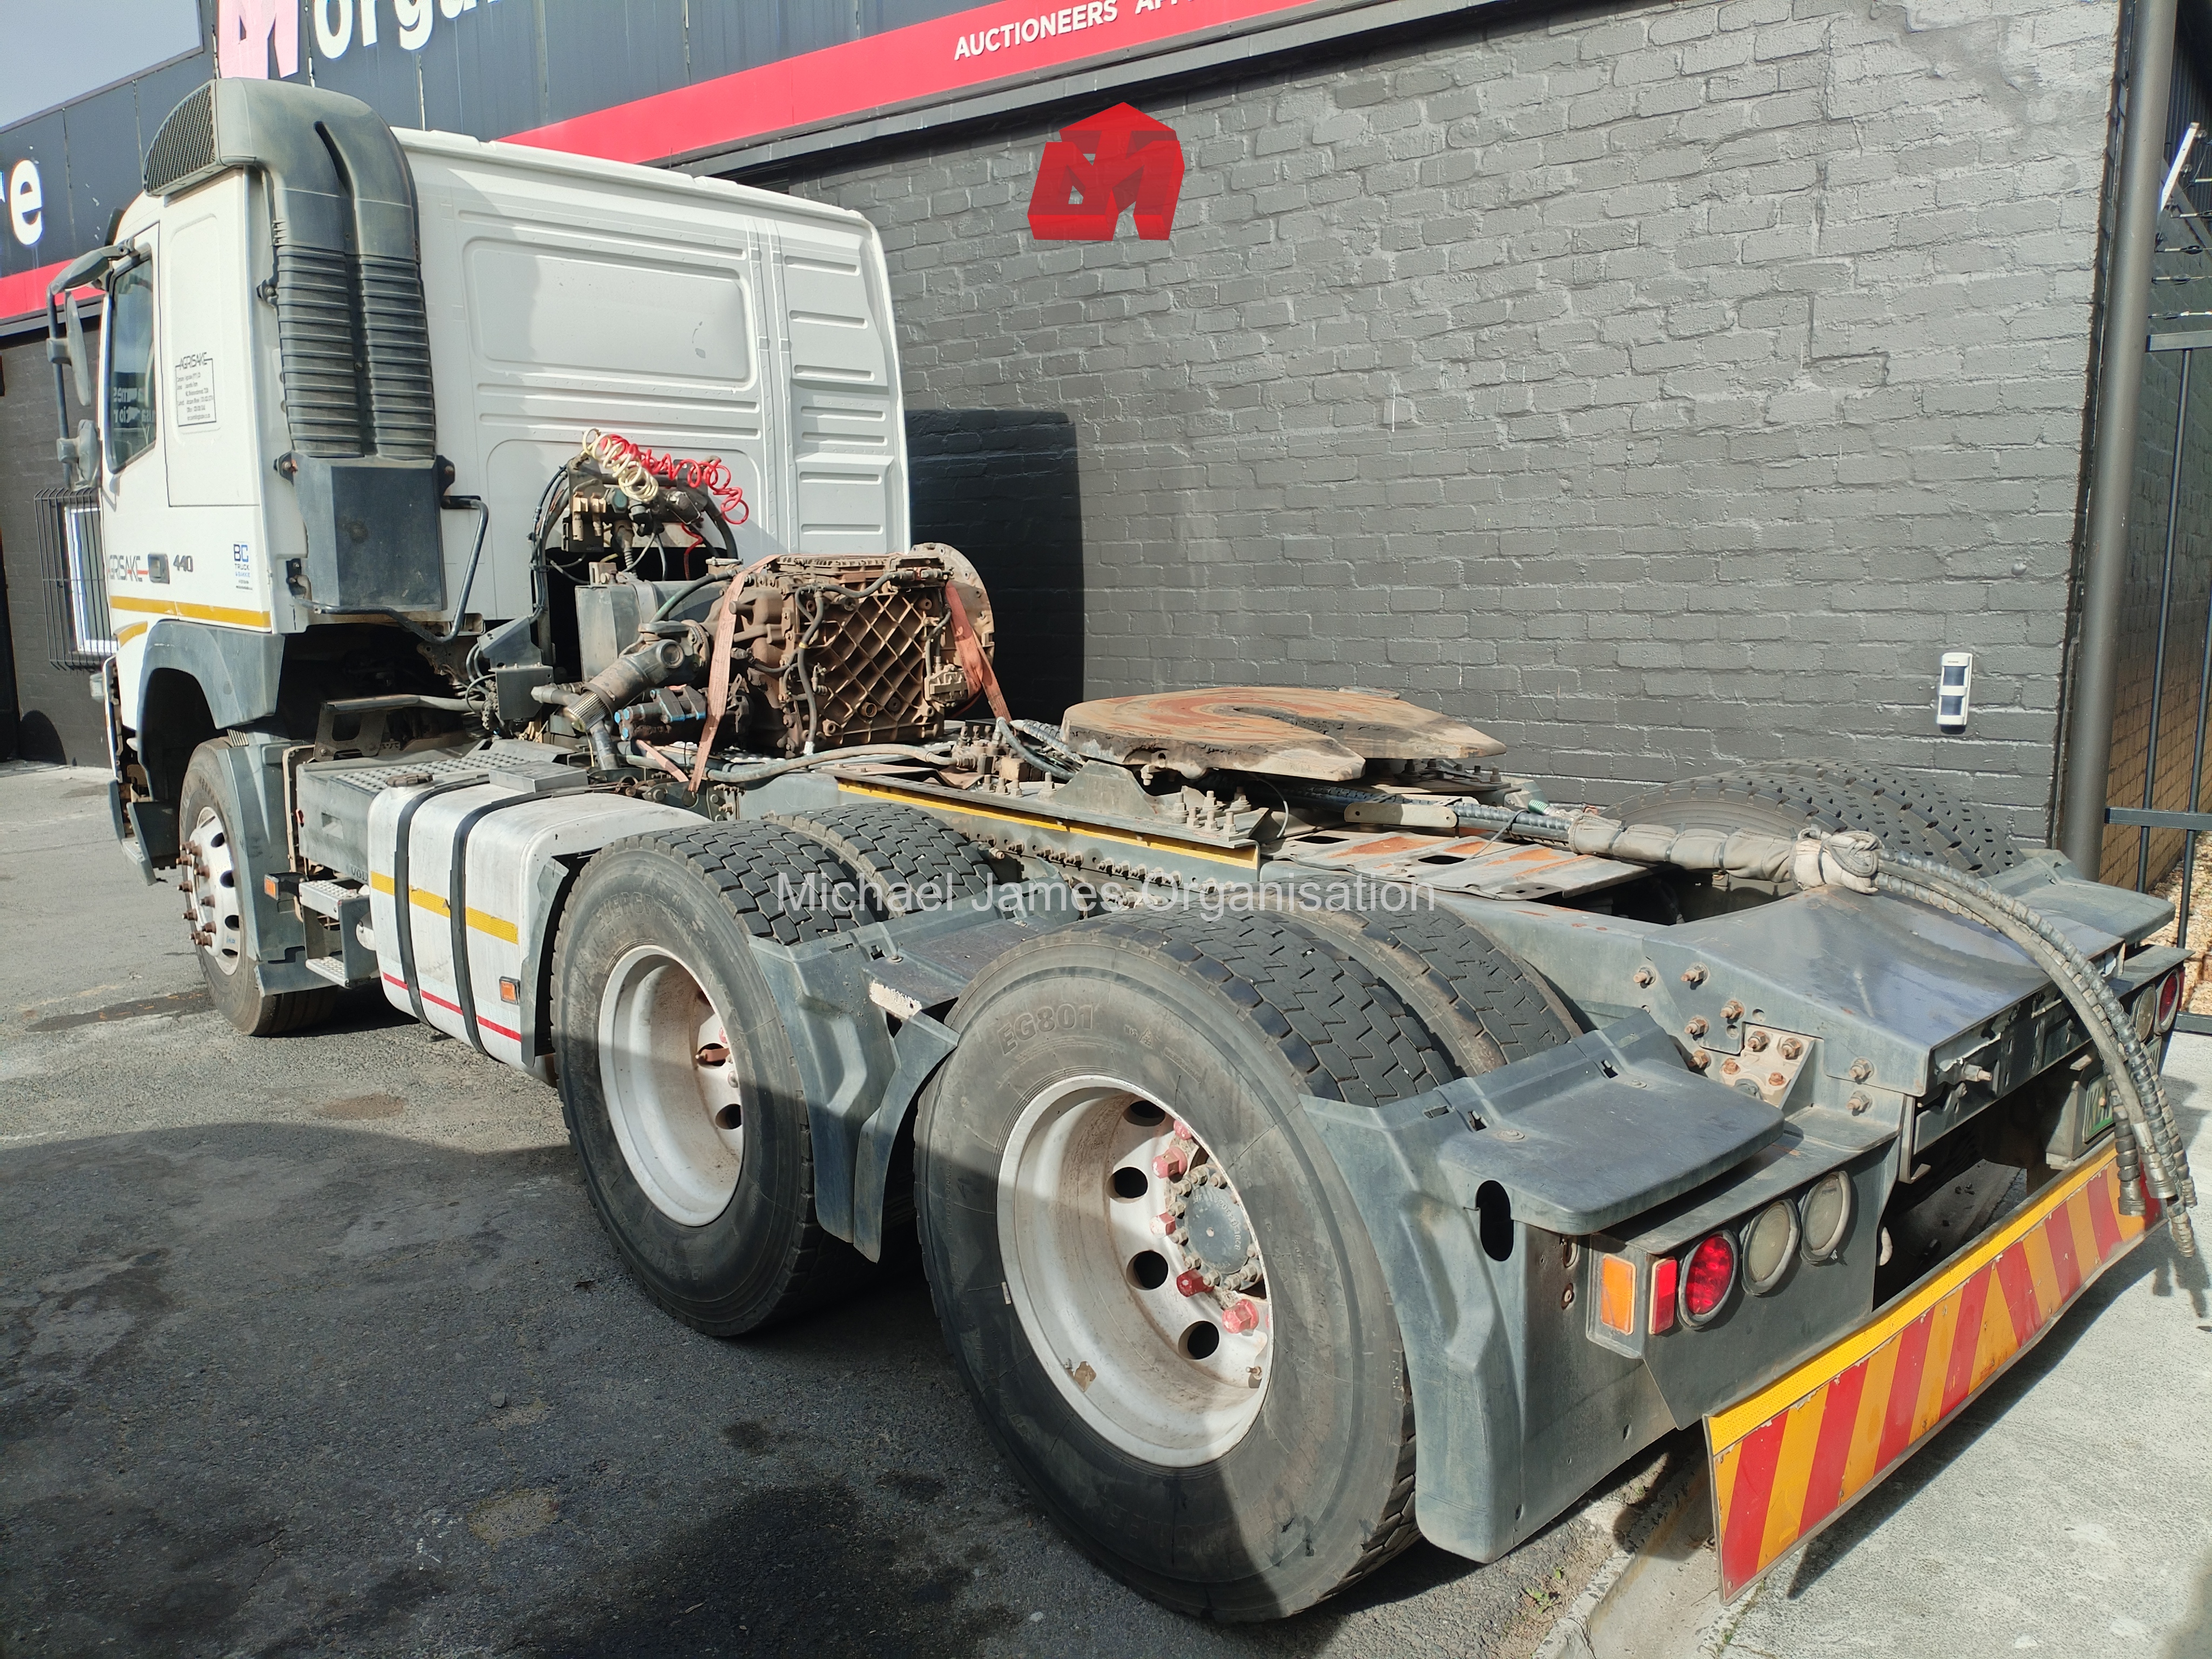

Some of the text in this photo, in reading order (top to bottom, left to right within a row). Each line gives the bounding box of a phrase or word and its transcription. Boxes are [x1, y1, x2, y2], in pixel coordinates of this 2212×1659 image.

[954, 0, 1118, 60] AUCTIONEERS
[173, 554, 193, 572] 440
[233, 544, 248, 562] BC
[997, 1003, 1095, 1055] EG801
